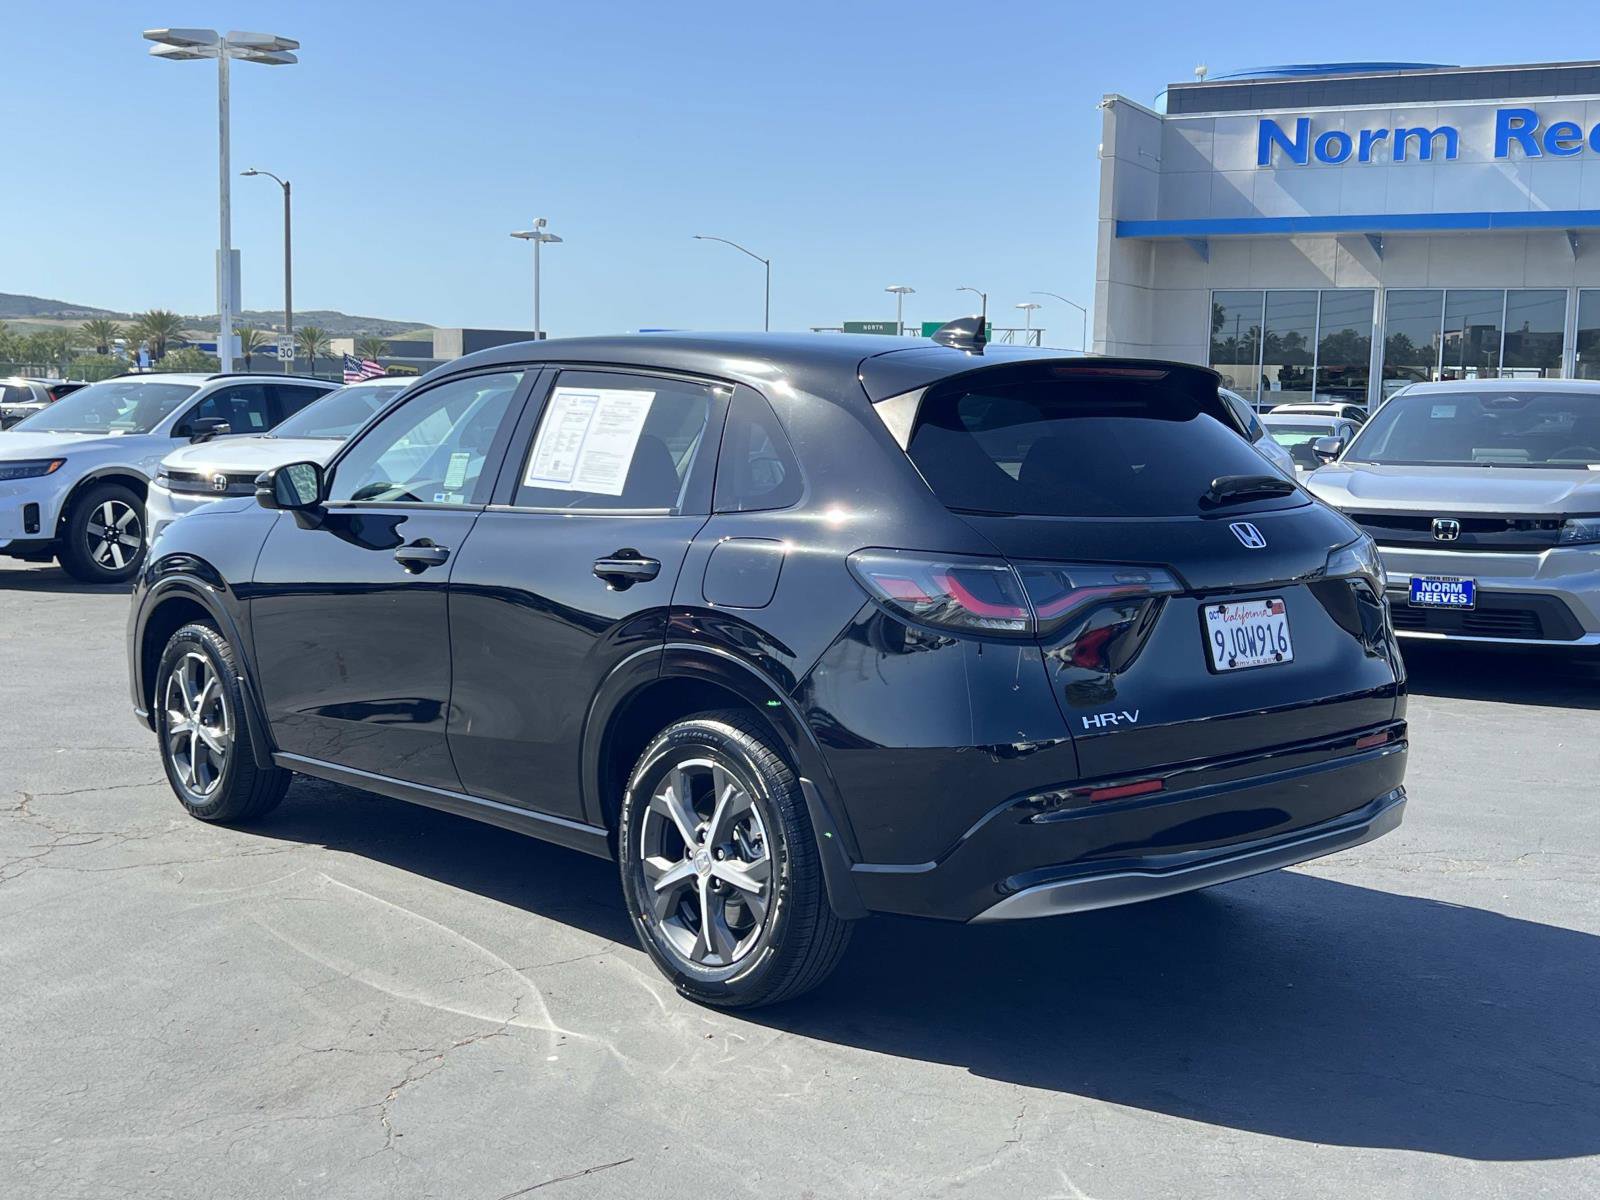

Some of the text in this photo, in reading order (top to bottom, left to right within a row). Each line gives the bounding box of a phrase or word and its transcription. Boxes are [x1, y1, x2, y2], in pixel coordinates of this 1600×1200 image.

[1257, 117, 1460, 167] Norm
[279, 348, 293, 358] 30
[1416, 591, 1467, 603] REEVES
[1421, 582, 1463, 593] NORM
[1223, 605, 1271, 625] California
[1214, 621, 1288, 662] 9JQW916
[1081, 709, 1140, 729] HR-V
